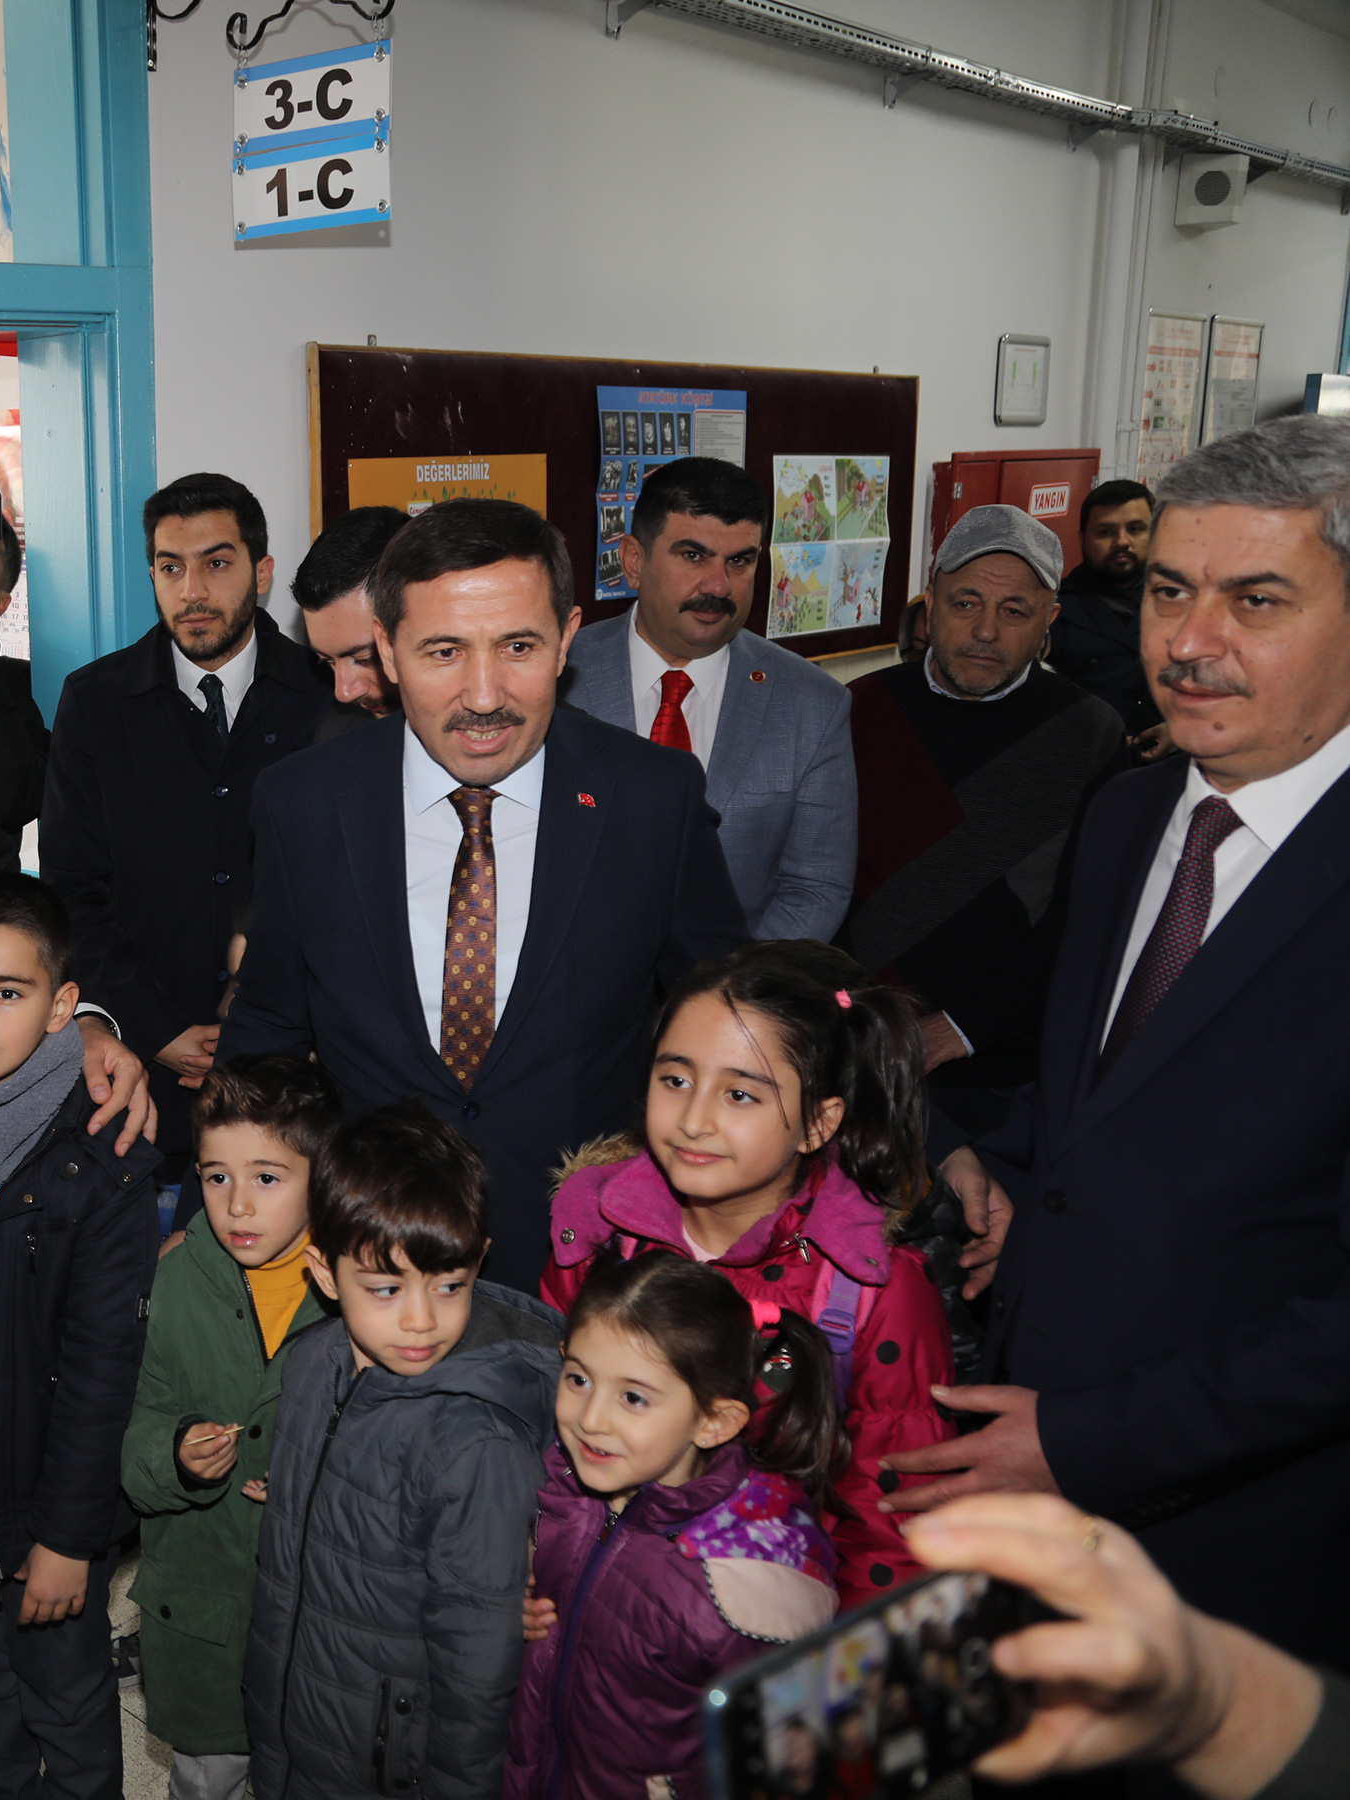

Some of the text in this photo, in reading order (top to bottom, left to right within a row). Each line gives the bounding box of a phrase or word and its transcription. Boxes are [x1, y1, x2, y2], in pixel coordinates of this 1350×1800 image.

[264, 68, 354, 130] 3-C
[265, 158, 355, 218] 1-C
[638, 389, 678, 405] ATATÜRK
[416, 459, 490, 483] DEĞERLERİMİZ
[1034, 490, 1066, 510] YANGIN
